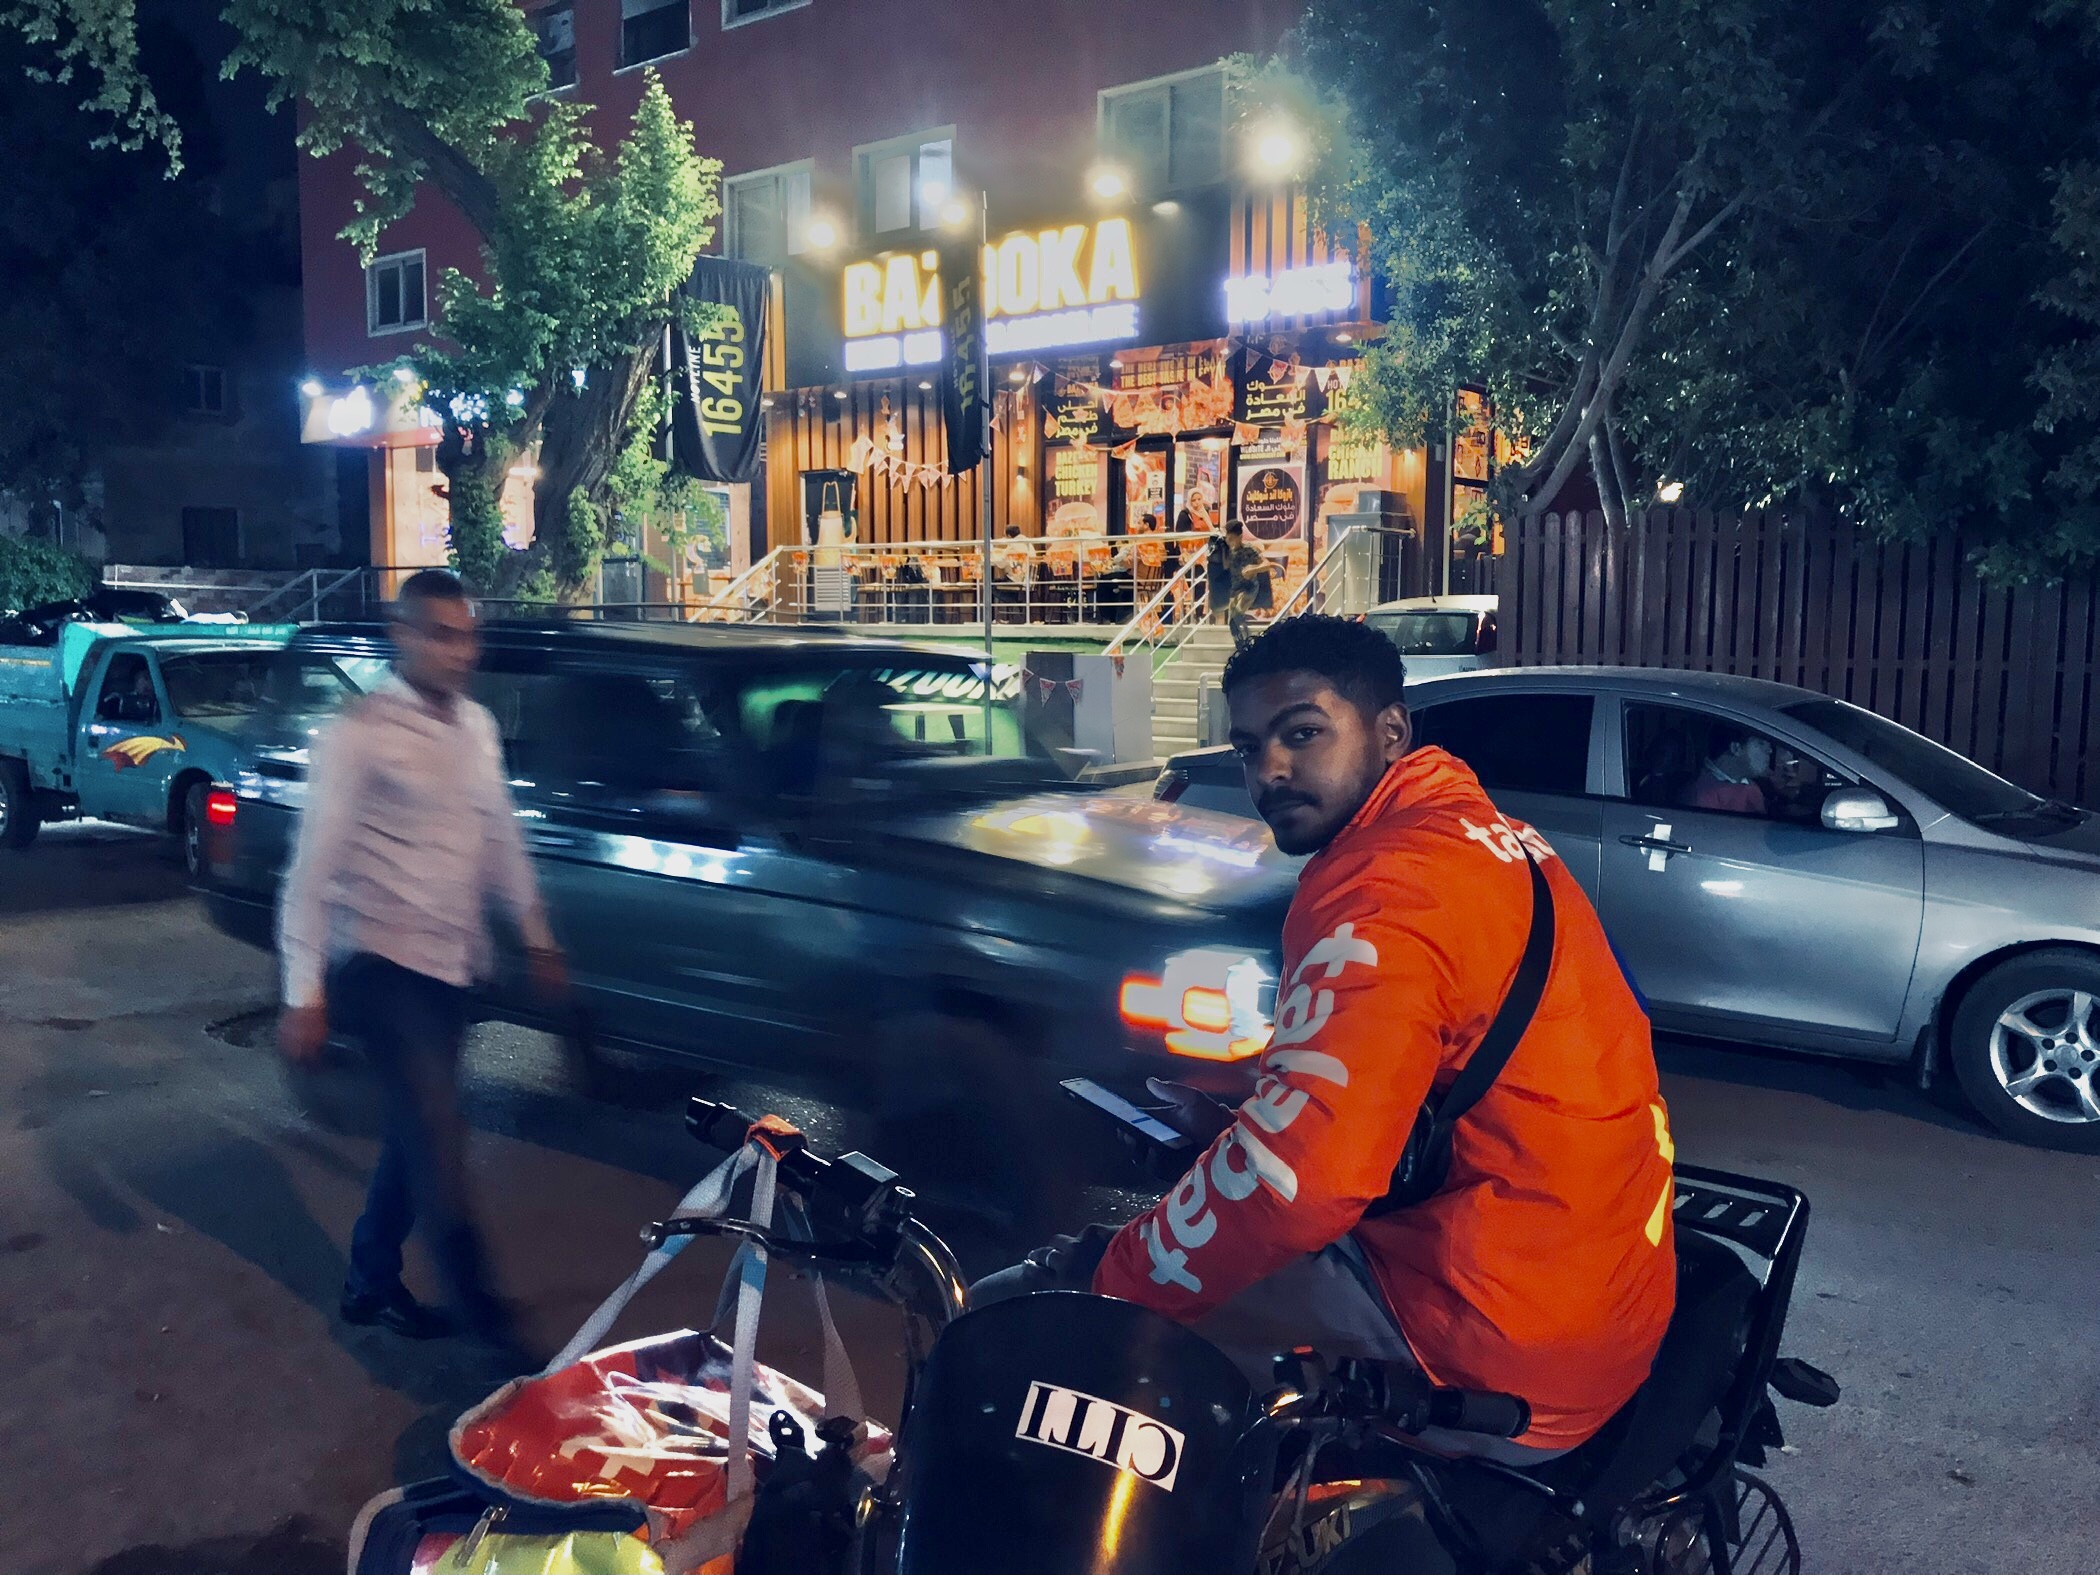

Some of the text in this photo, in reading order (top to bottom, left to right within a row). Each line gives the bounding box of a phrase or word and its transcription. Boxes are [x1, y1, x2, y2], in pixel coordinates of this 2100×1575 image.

[701, 318, 745, 437] 16455
[1120, 374, 1135, 389] THE
[1137, 372, 1157, 387] BEST
[1055, 463, 1098, 479] CHICKEN
[1328, 458, 1383, 480] RANCH
[1055, 479, 1097, 497] TURKEY
[1245, 503, 1296, 512] ملوك السعادة
[1245, 514, 1279, 523] مصر
[1019, 1384, 1178, 1482] CITI
